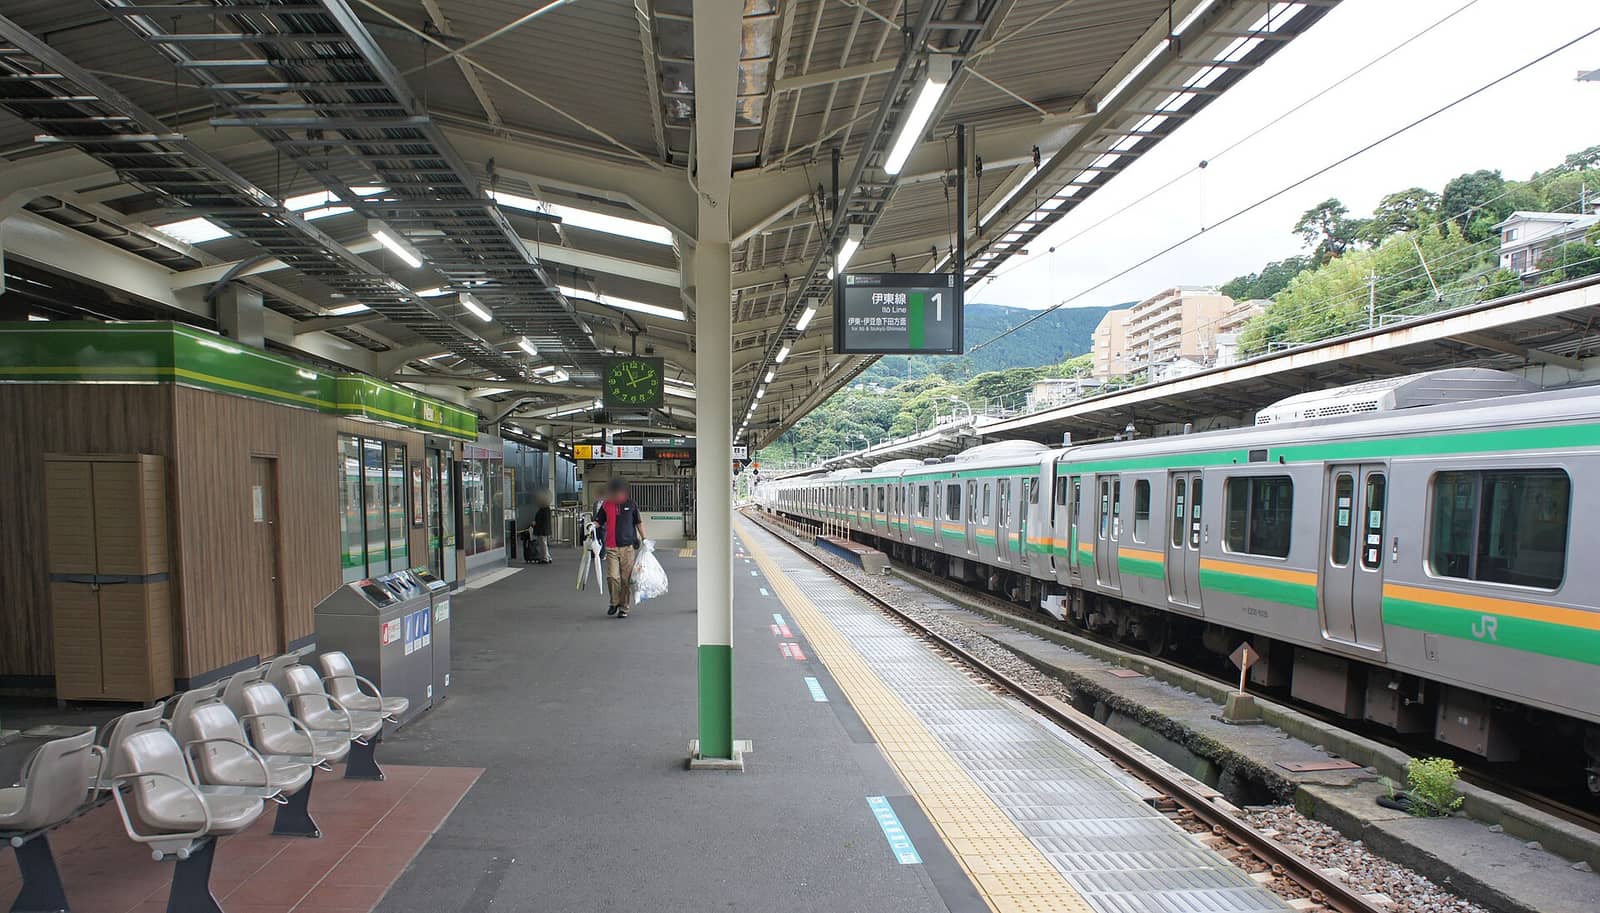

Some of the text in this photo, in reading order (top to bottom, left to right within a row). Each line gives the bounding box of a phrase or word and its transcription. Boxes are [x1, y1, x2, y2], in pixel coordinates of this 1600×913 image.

[872, 293, 907, 305] 伊東線
[931, 293, 943, 322] 1
[1472, 615, 1498, 641] JR
